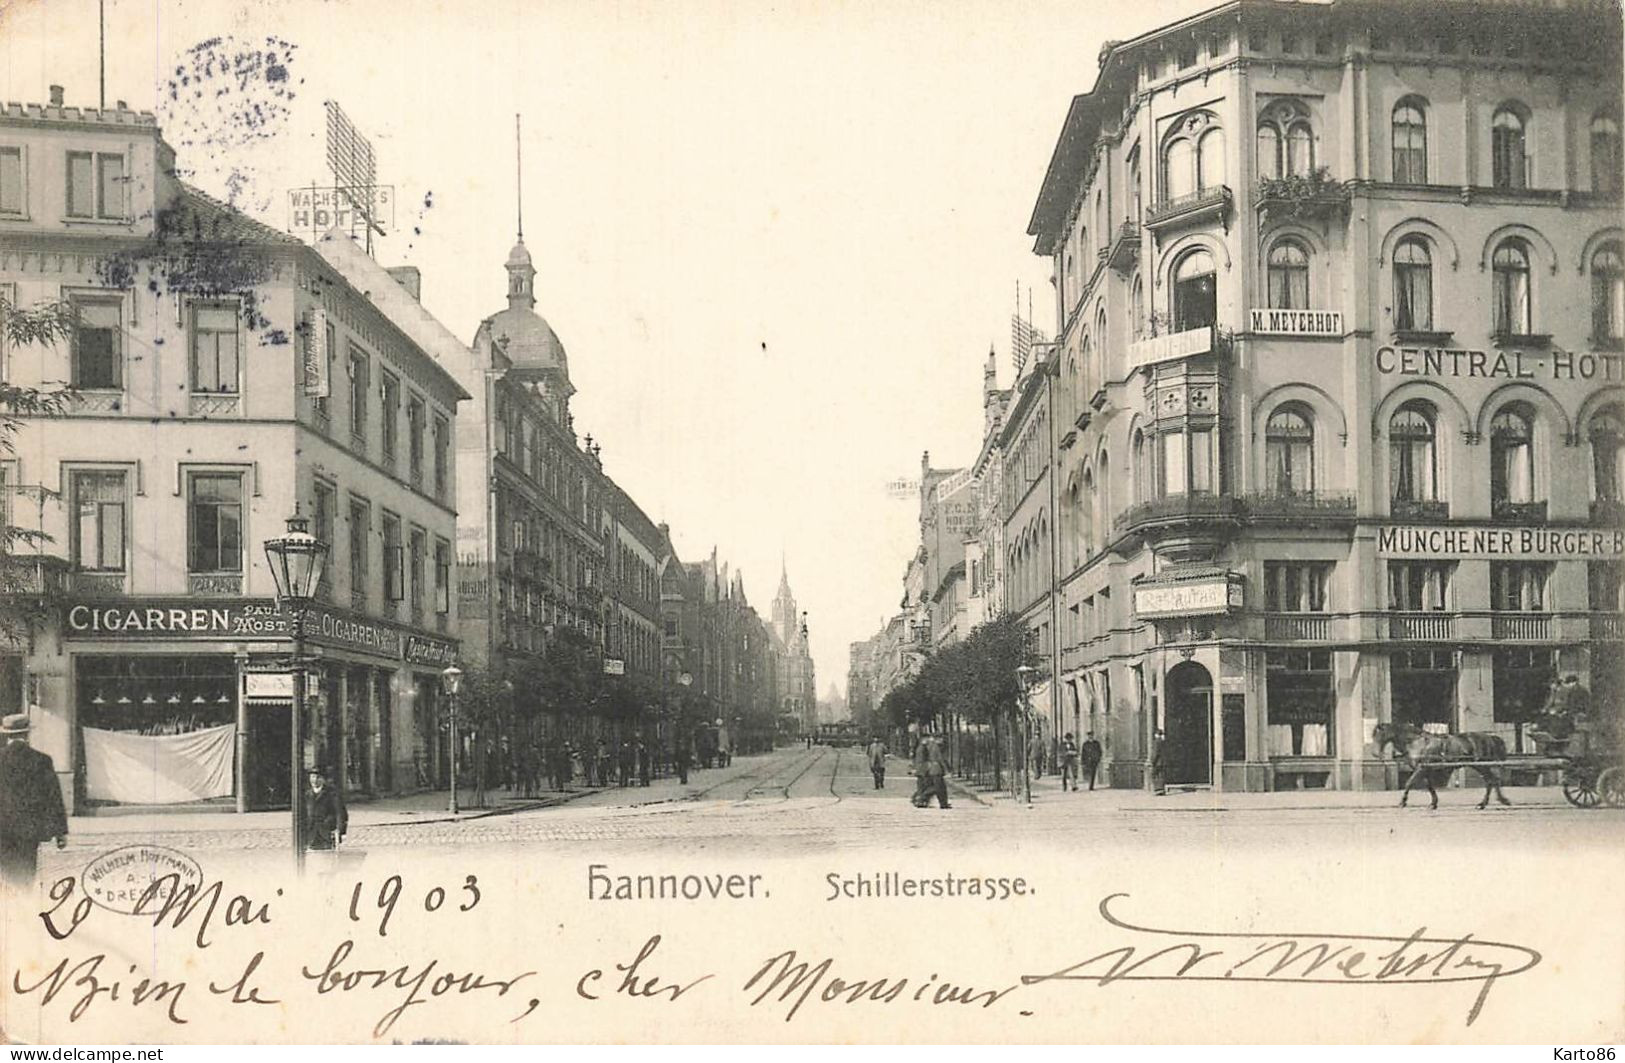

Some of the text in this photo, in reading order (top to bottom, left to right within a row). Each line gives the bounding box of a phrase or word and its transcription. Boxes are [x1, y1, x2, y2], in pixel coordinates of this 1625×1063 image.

[1251, 311, 1340, 333] M. MEYERHOF
[1376, 346, 1624, 382] CENTRAL HOT
[1379, 526, 1513, 554] MÜNCHENER
[69, 605, 230, 631] CIGARREN
[243, 604, 282, 616] PAUL
[322, 613, 381, 647] CIGARREN
[133, 873, 284, 948] Mai
[13, 954, 189, 1024] Bien
[209, 951, 281, 1005] le
[576, 934, 716, 1002] cher
